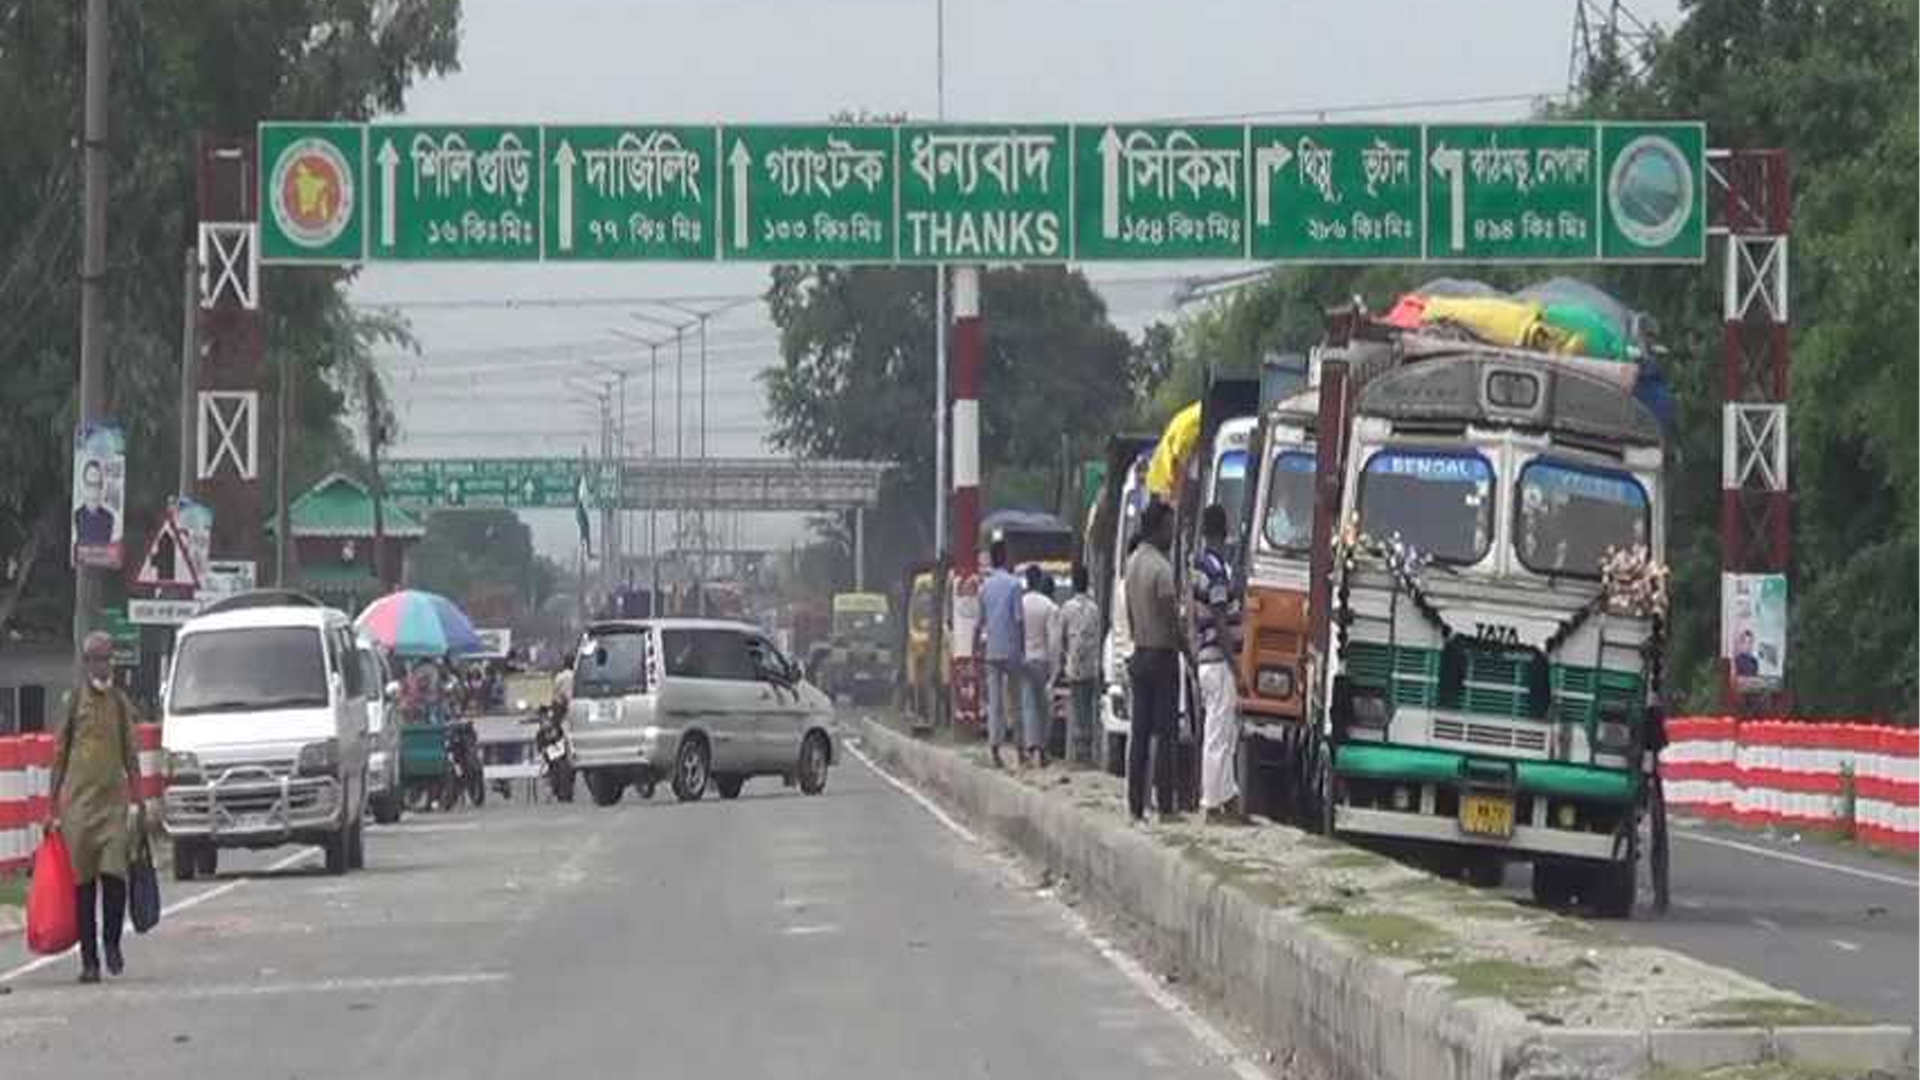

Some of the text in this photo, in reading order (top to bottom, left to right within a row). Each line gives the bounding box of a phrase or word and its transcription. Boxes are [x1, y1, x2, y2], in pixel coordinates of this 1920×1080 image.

[410, 132, 532, 206] শিলিগুড়ি
[582, 130, 701, 202] দার্জিলিং
[764, 133, 886, 198] গ্যাংটক
[911, 133, 1056, 194] ধন্যবাদ
[1123, 130, 1241, 201] সিকিম
[906, 211, 1060, 256] THANKS
[1474, 621, 1520, 646] TATA
